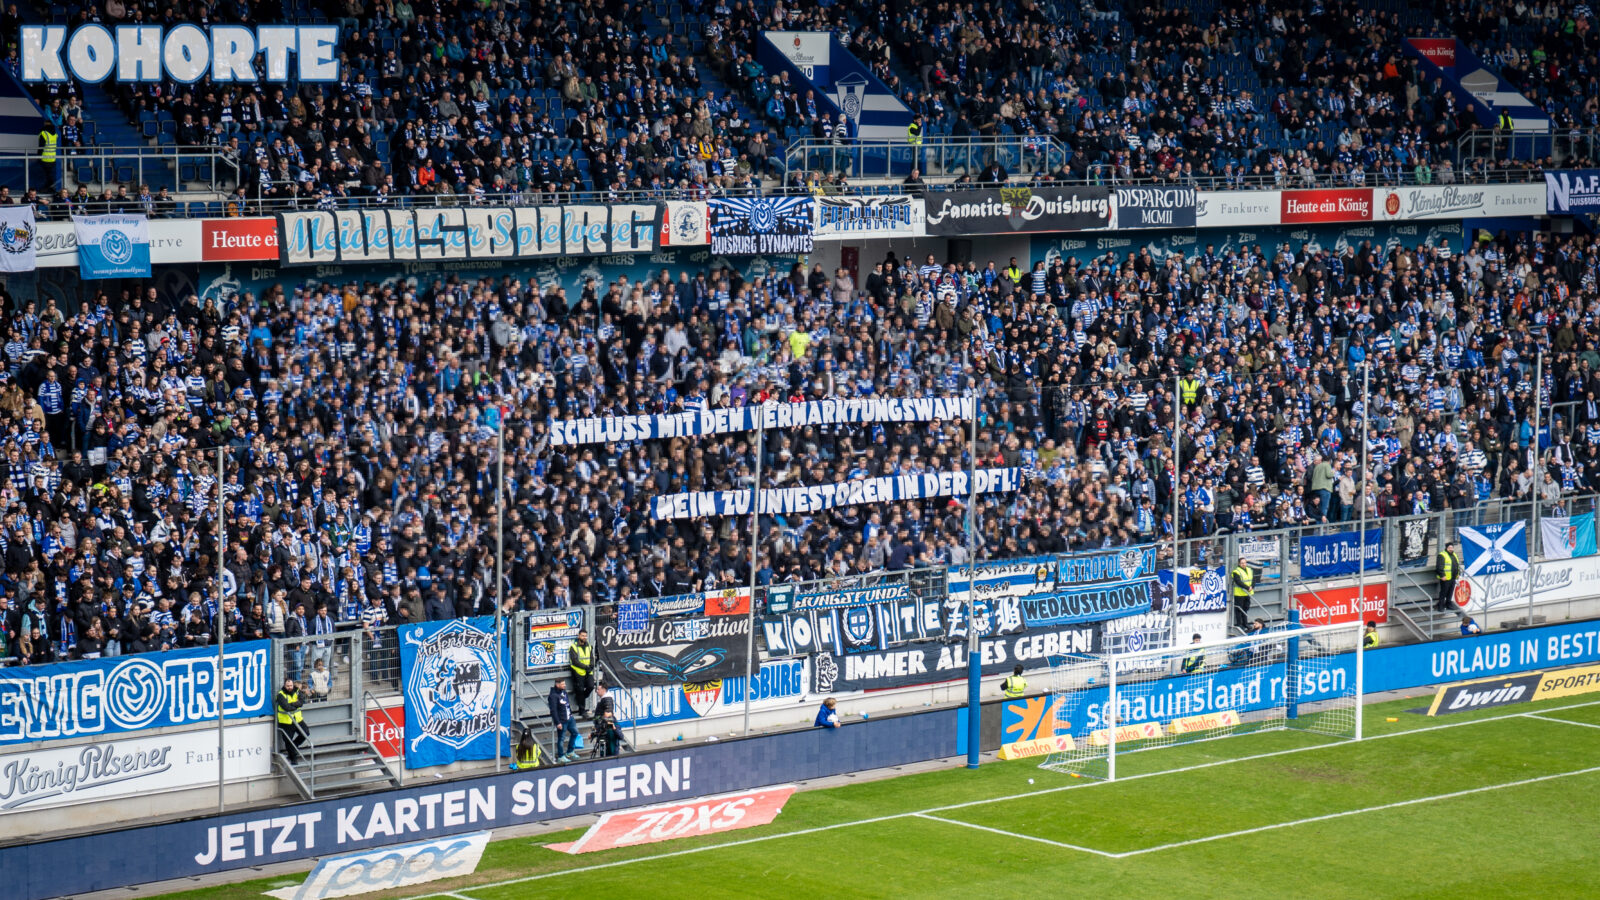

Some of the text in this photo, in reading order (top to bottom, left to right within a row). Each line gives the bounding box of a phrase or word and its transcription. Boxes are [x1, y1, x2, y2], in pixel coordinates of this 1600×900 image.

[927, 195, 1108, 225] Fanatics Duisburg
[1117, 188, 1196, 208] DISPARGUM
[1220, 202, 1269, 214] Fankurve
[1287, 198, 1368, 217] Heute ein König
[1407, 186, 1538, 215] König Pilsener Fankurve
[1141, 209, 1173, 224] MCMII
[211, 230, 279, 248] Heute ei
[288, 214, 482, 252] Meidericher
[493, 212, 654, 254] Spielverein
[711, 234, 814, 255] DUISBURG DYNAMITES
[550, 397, 972, 446] SCHLUSS MIT DEM VERMARKTUNGSWAHN
[656, 467, 1019, 520] NEIN ZU INVESTOREN IN DER DFL!
[1486, 524, 1502, 534] MSV
[1304, 545, 1330, 566] Block
[1340, 540, 1378, 563] Duisurg
[1058, 554, 1121, 583] METROPOL
[1486, 563, 1506, 573] PTFC
[618, 602, 648, 612] SEKTION
[1022, 582, 1149, 621] WEDAUSTADION
[1330, 600, 1348, 617] ein
[1350, 596, 1386, 617] König
[618, 611, 649, 621] STADION
[764, 602, 941, 650] KOHRTE
[1177, 622, 1222, 634] ankurve
[417, 629, 495, 662] Hafenstadt
[845, 628, 1093, 680] IMMER ALES GEBEN!
[1432, 631, 1600, 678] URLAUB IN BEST
[0, 649, 267, 740] EWIG TREU
[722, 663, 802, 706] DUSBURG
[1448, 682, 1527, 710] bwin
[610, 682, 684, 723] UHRPOTT
[368, 721, 404, 743] Heu
[1100, 727, 1140, 742] Snalco
[1180, 714, 1217, 731] Sinalco
[1011, 741, 1052, 758] Sinalco
[0, 757, 78, 799] König
[76, 743, 172, 780] Pilsener
[194, 756, 691, 866] JETZT KARTEN SICHERN!
